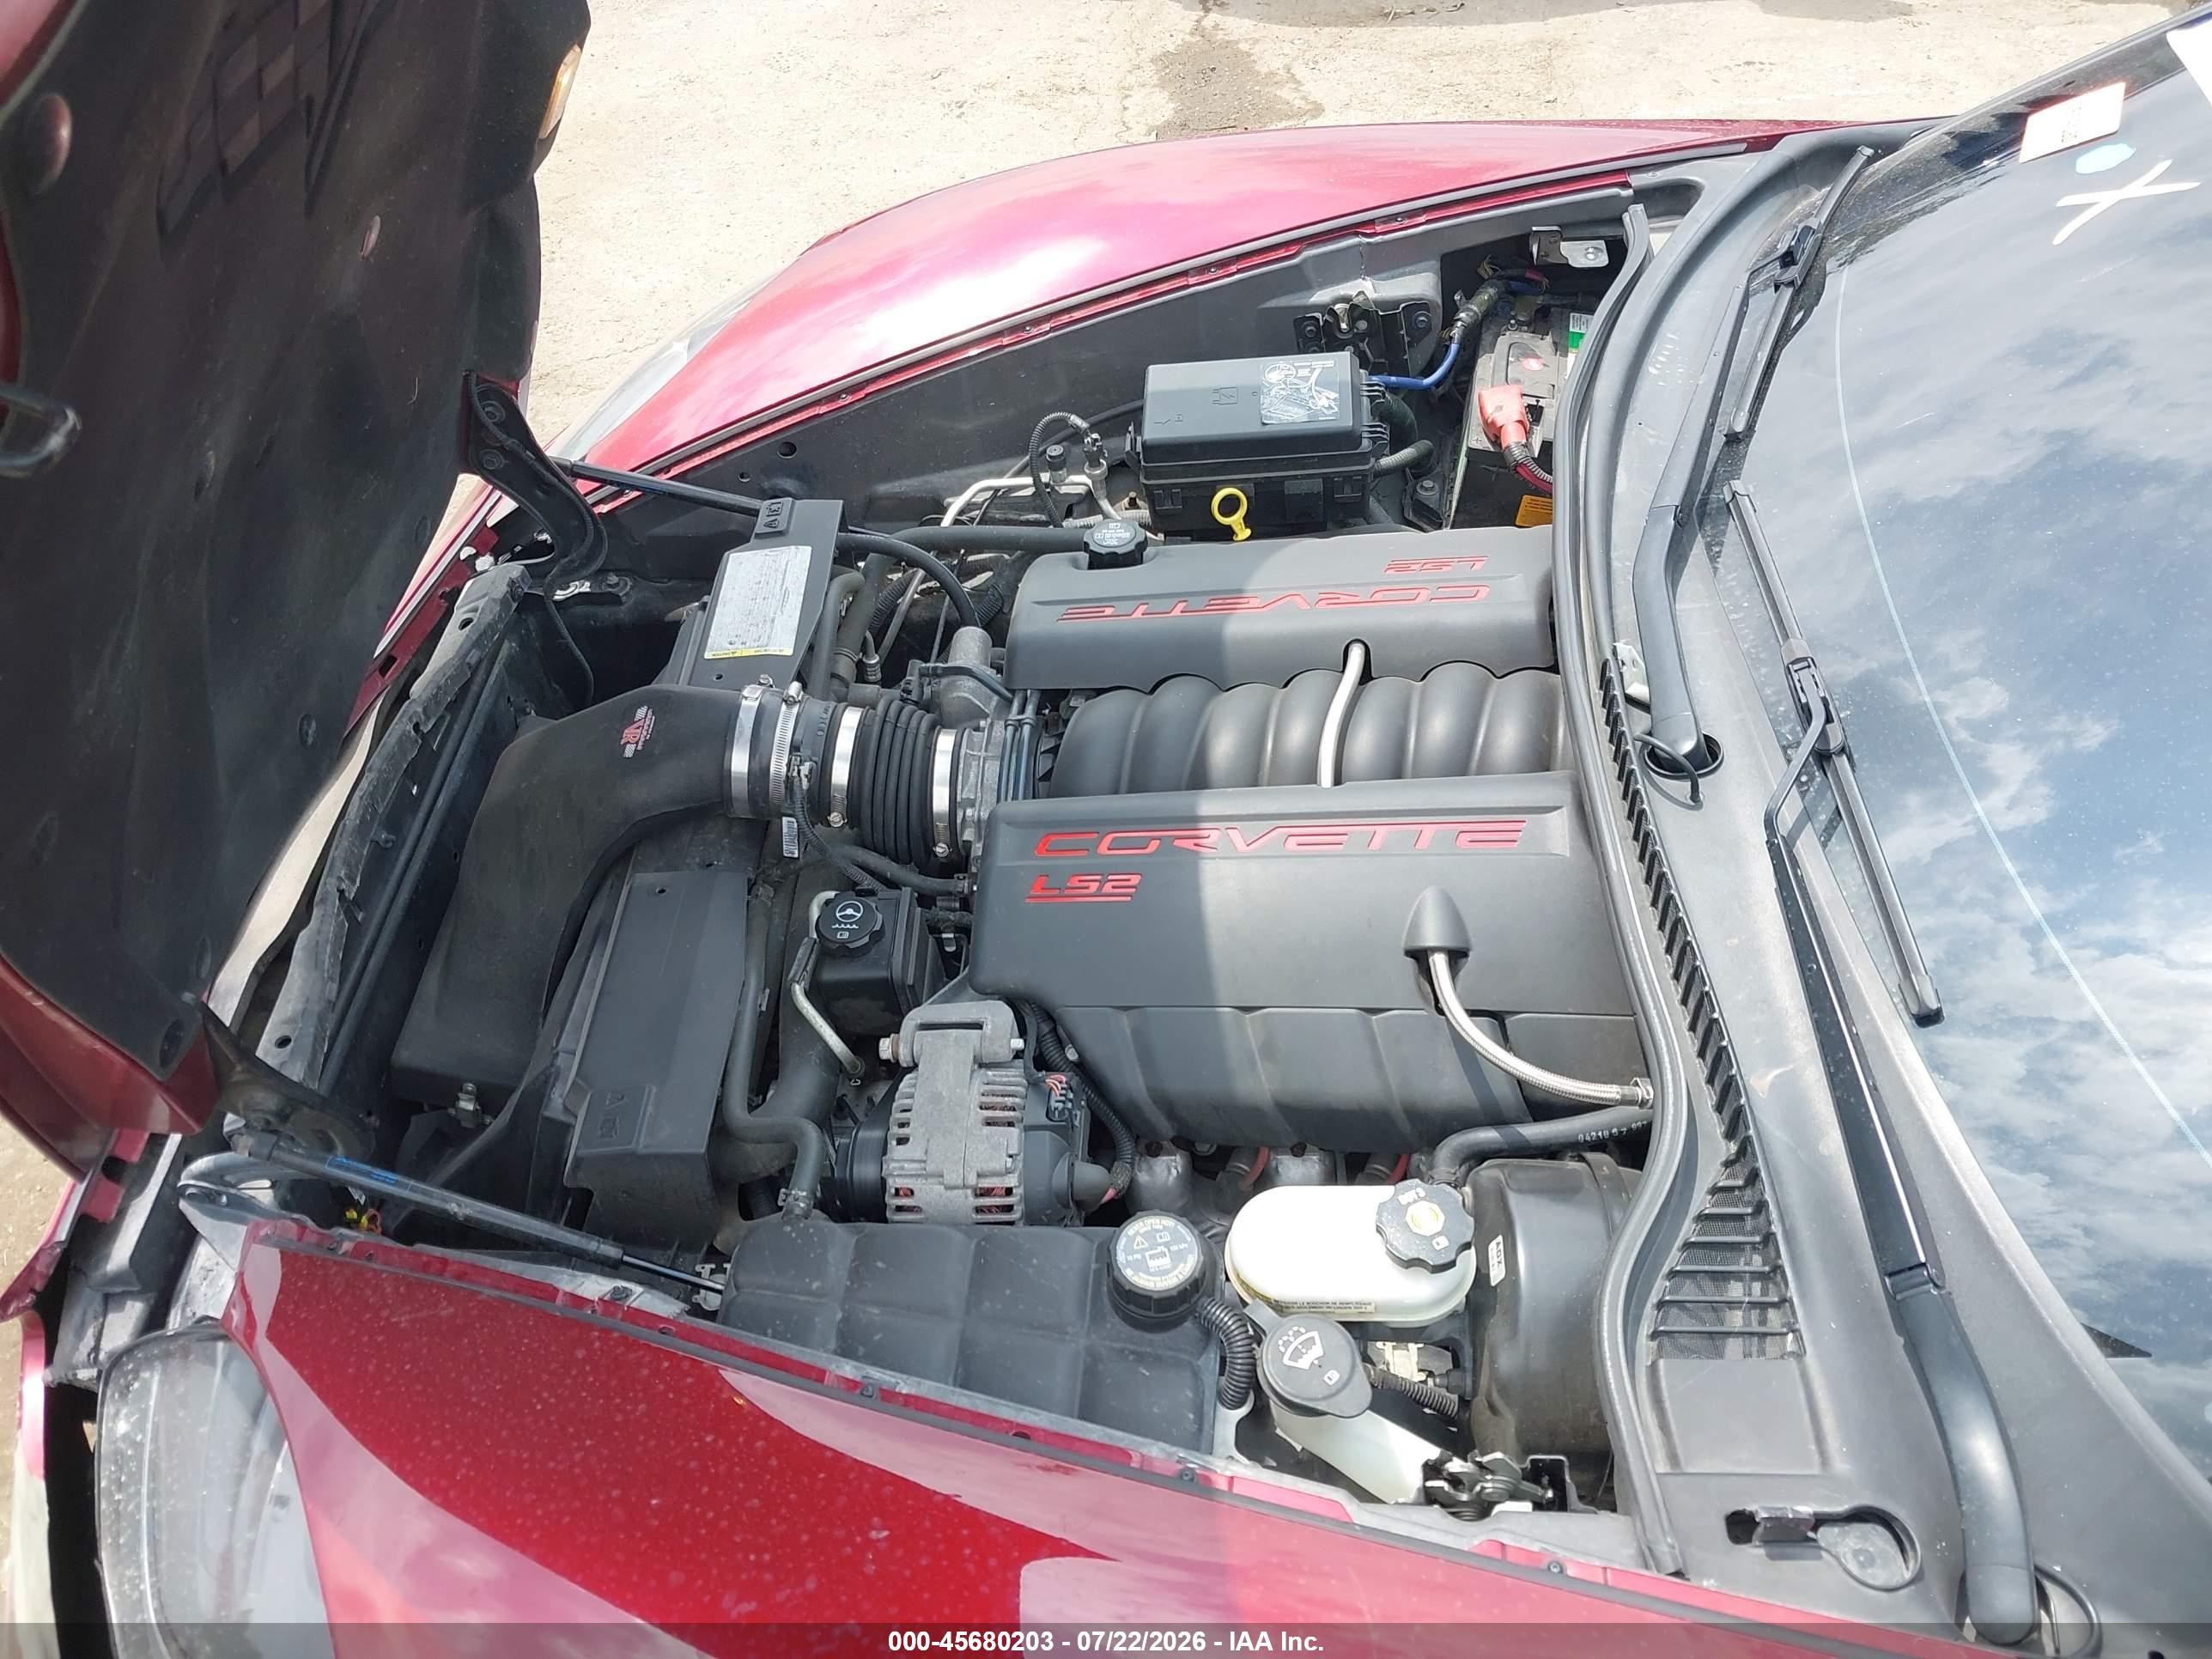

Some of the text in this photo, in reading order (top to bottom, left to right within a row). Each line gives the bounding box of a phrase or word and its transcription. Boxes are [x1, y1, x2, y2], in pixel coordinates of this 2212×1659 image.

[1383, 555, 1490, 574] LS2
[1056, 584, 1491, 623] CORVETTE
[1033, 819, 1528, 858] CORVETTE
[1026, 872, 1142, 899] LS2
